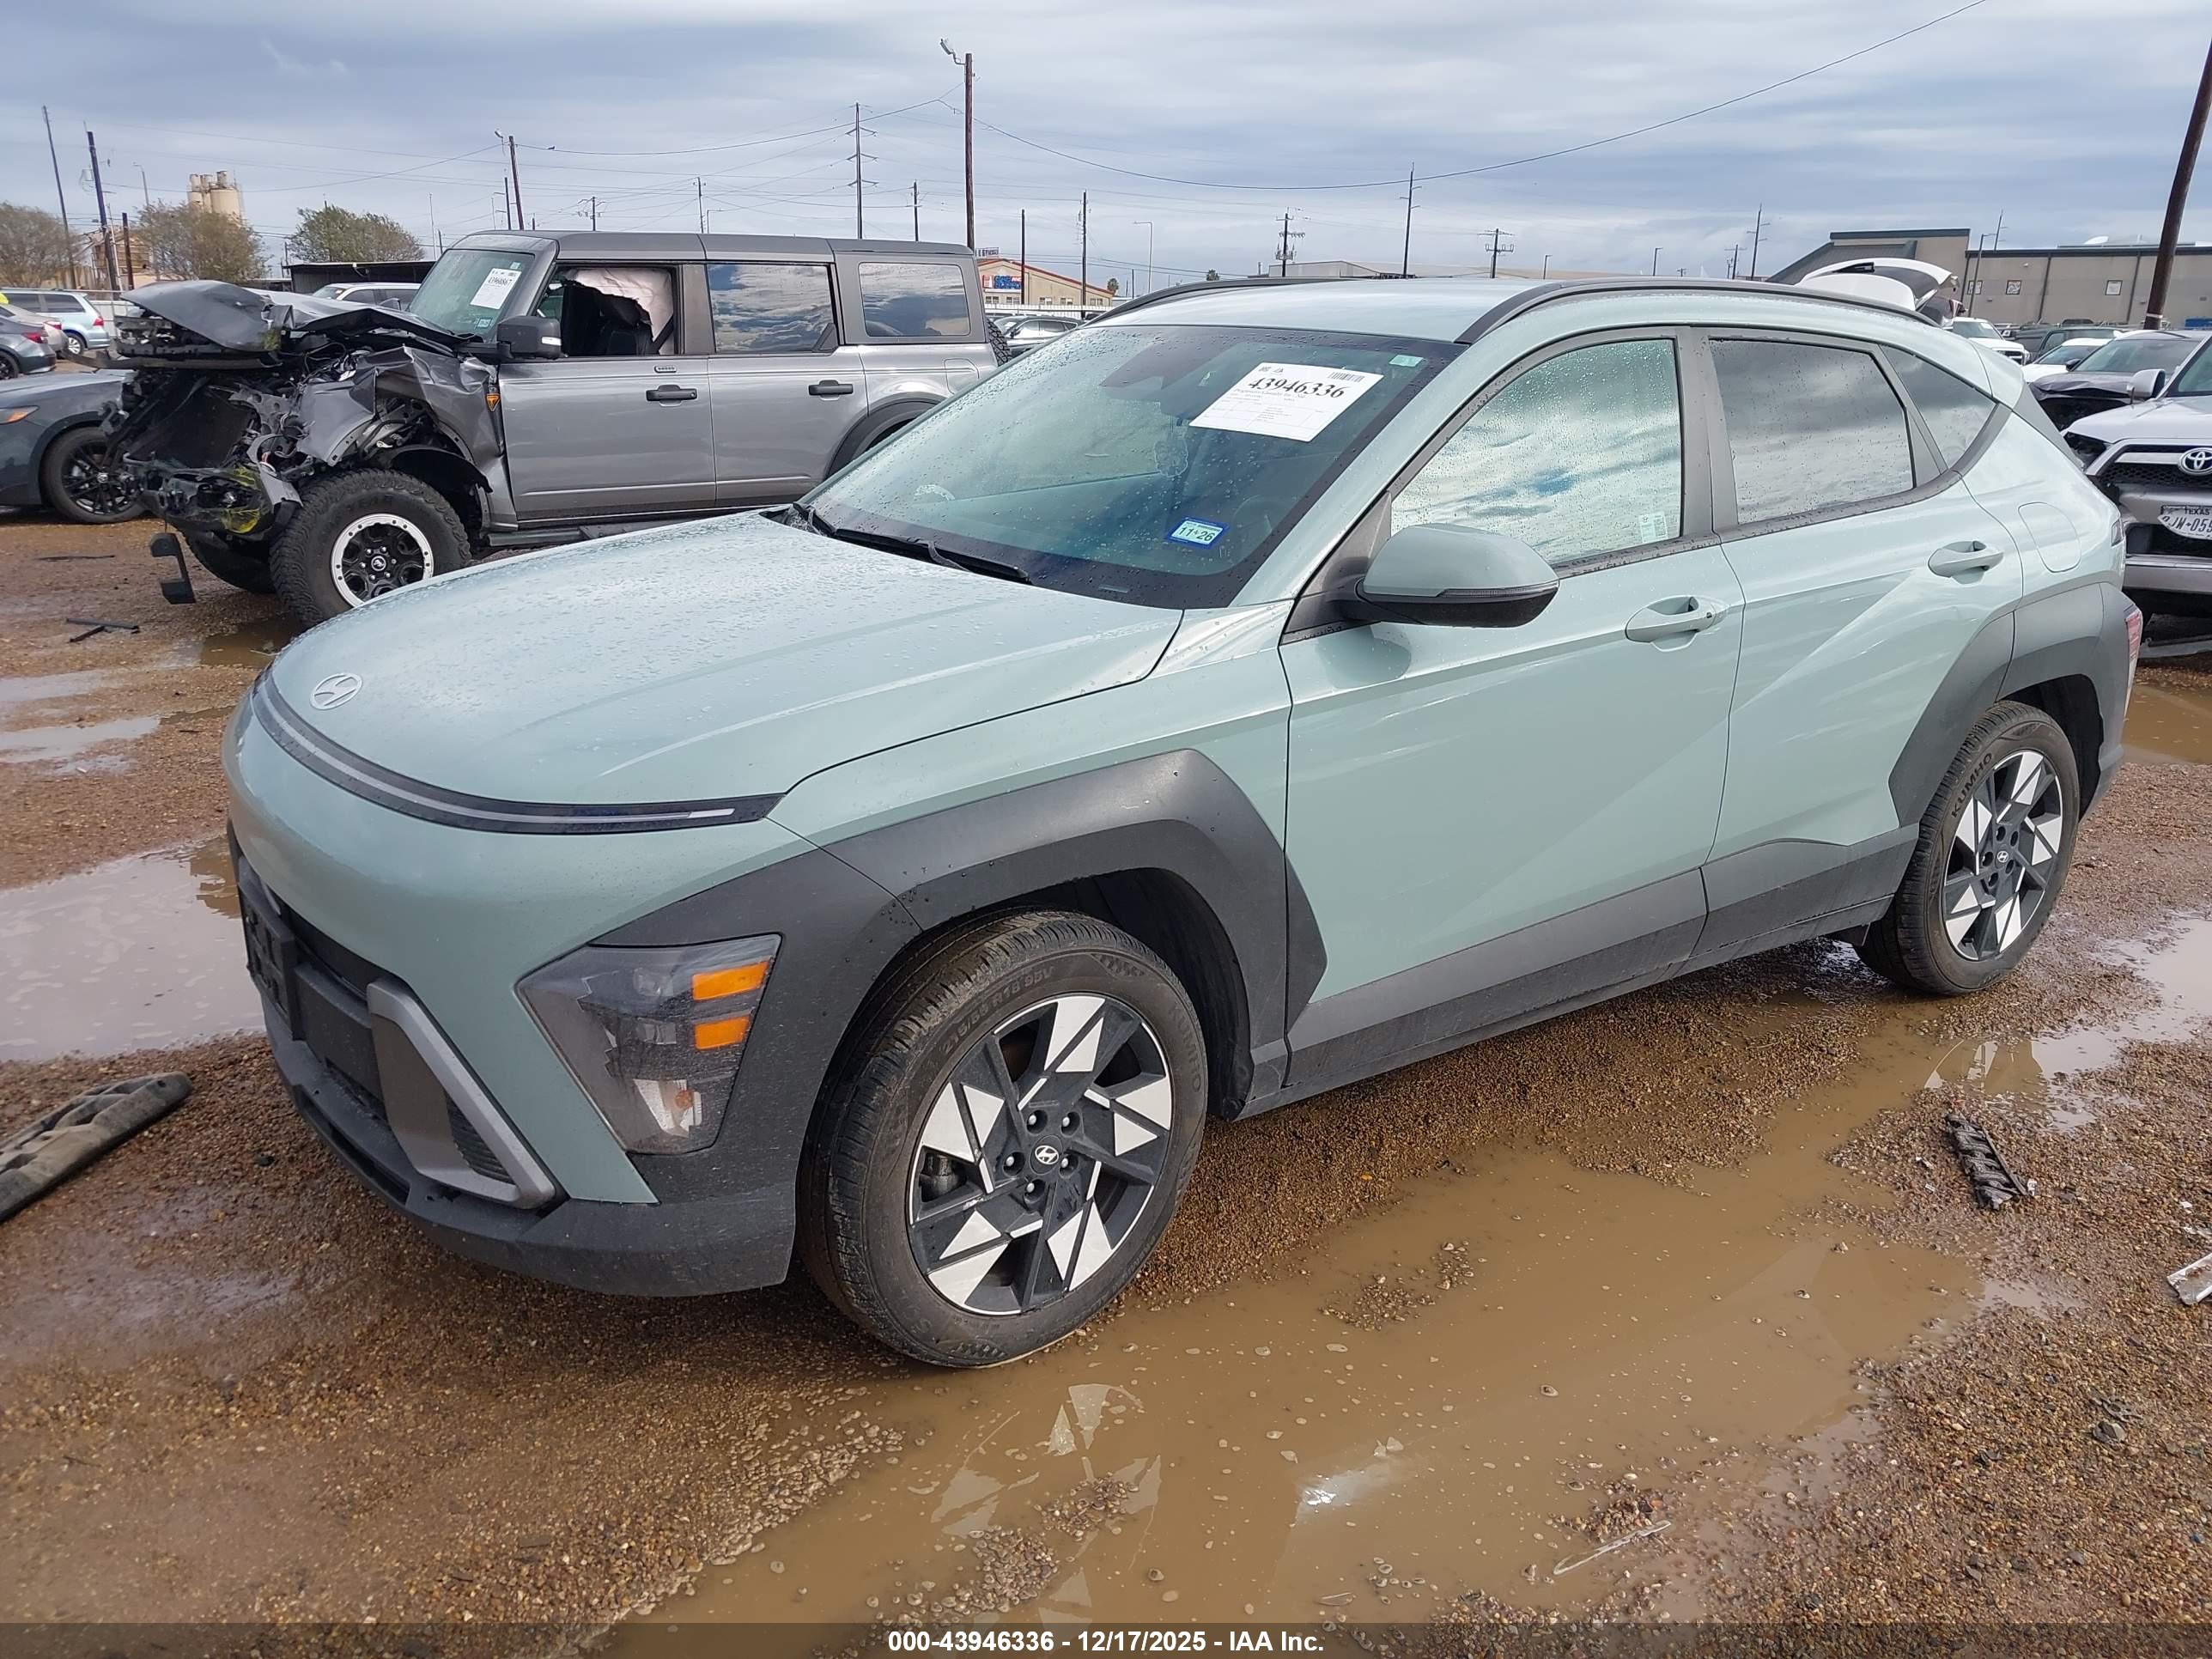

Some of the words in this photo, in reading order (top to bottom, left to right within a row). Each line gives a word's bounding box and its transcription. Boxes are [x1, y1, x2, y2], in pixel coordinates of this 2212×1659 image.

[1248, 378, 1351, 398] 43946336
[2184, 505, 2210, 515] TEXAS
[1178, 526, 1194, 537] 11
[1196, 531, 1216, 542] 26
[1951, 752, 1993, 818] KUMHO
